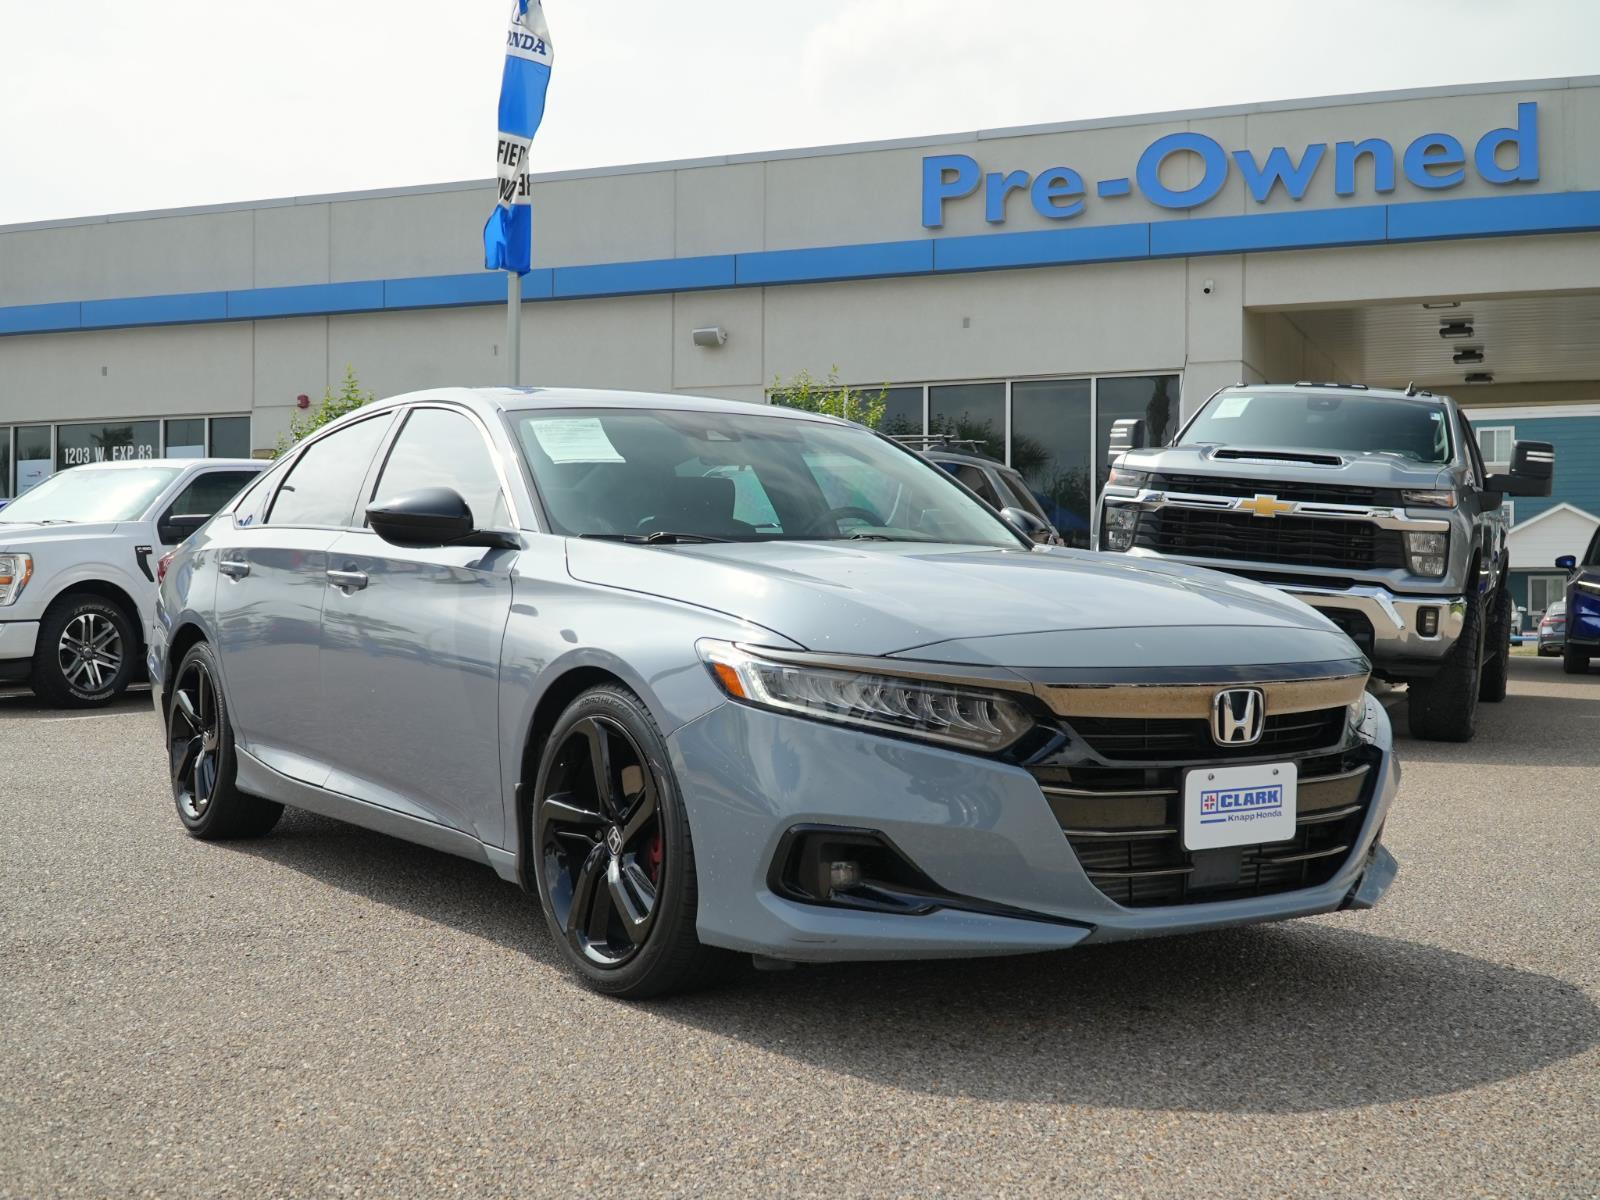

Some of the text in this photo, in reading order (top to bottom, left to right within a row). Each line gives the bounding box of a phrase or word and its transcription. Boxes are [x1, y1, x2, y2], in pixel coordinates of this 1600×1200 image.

[922, 101, 1540, 229] Pre-Owned
[64, 447, 90, 465] 1203
[138, 444, 153, 461] 83
[1220, 790, 1279, 808] CLARK
[1227, 810, 1282, 823] Knapp Honda
